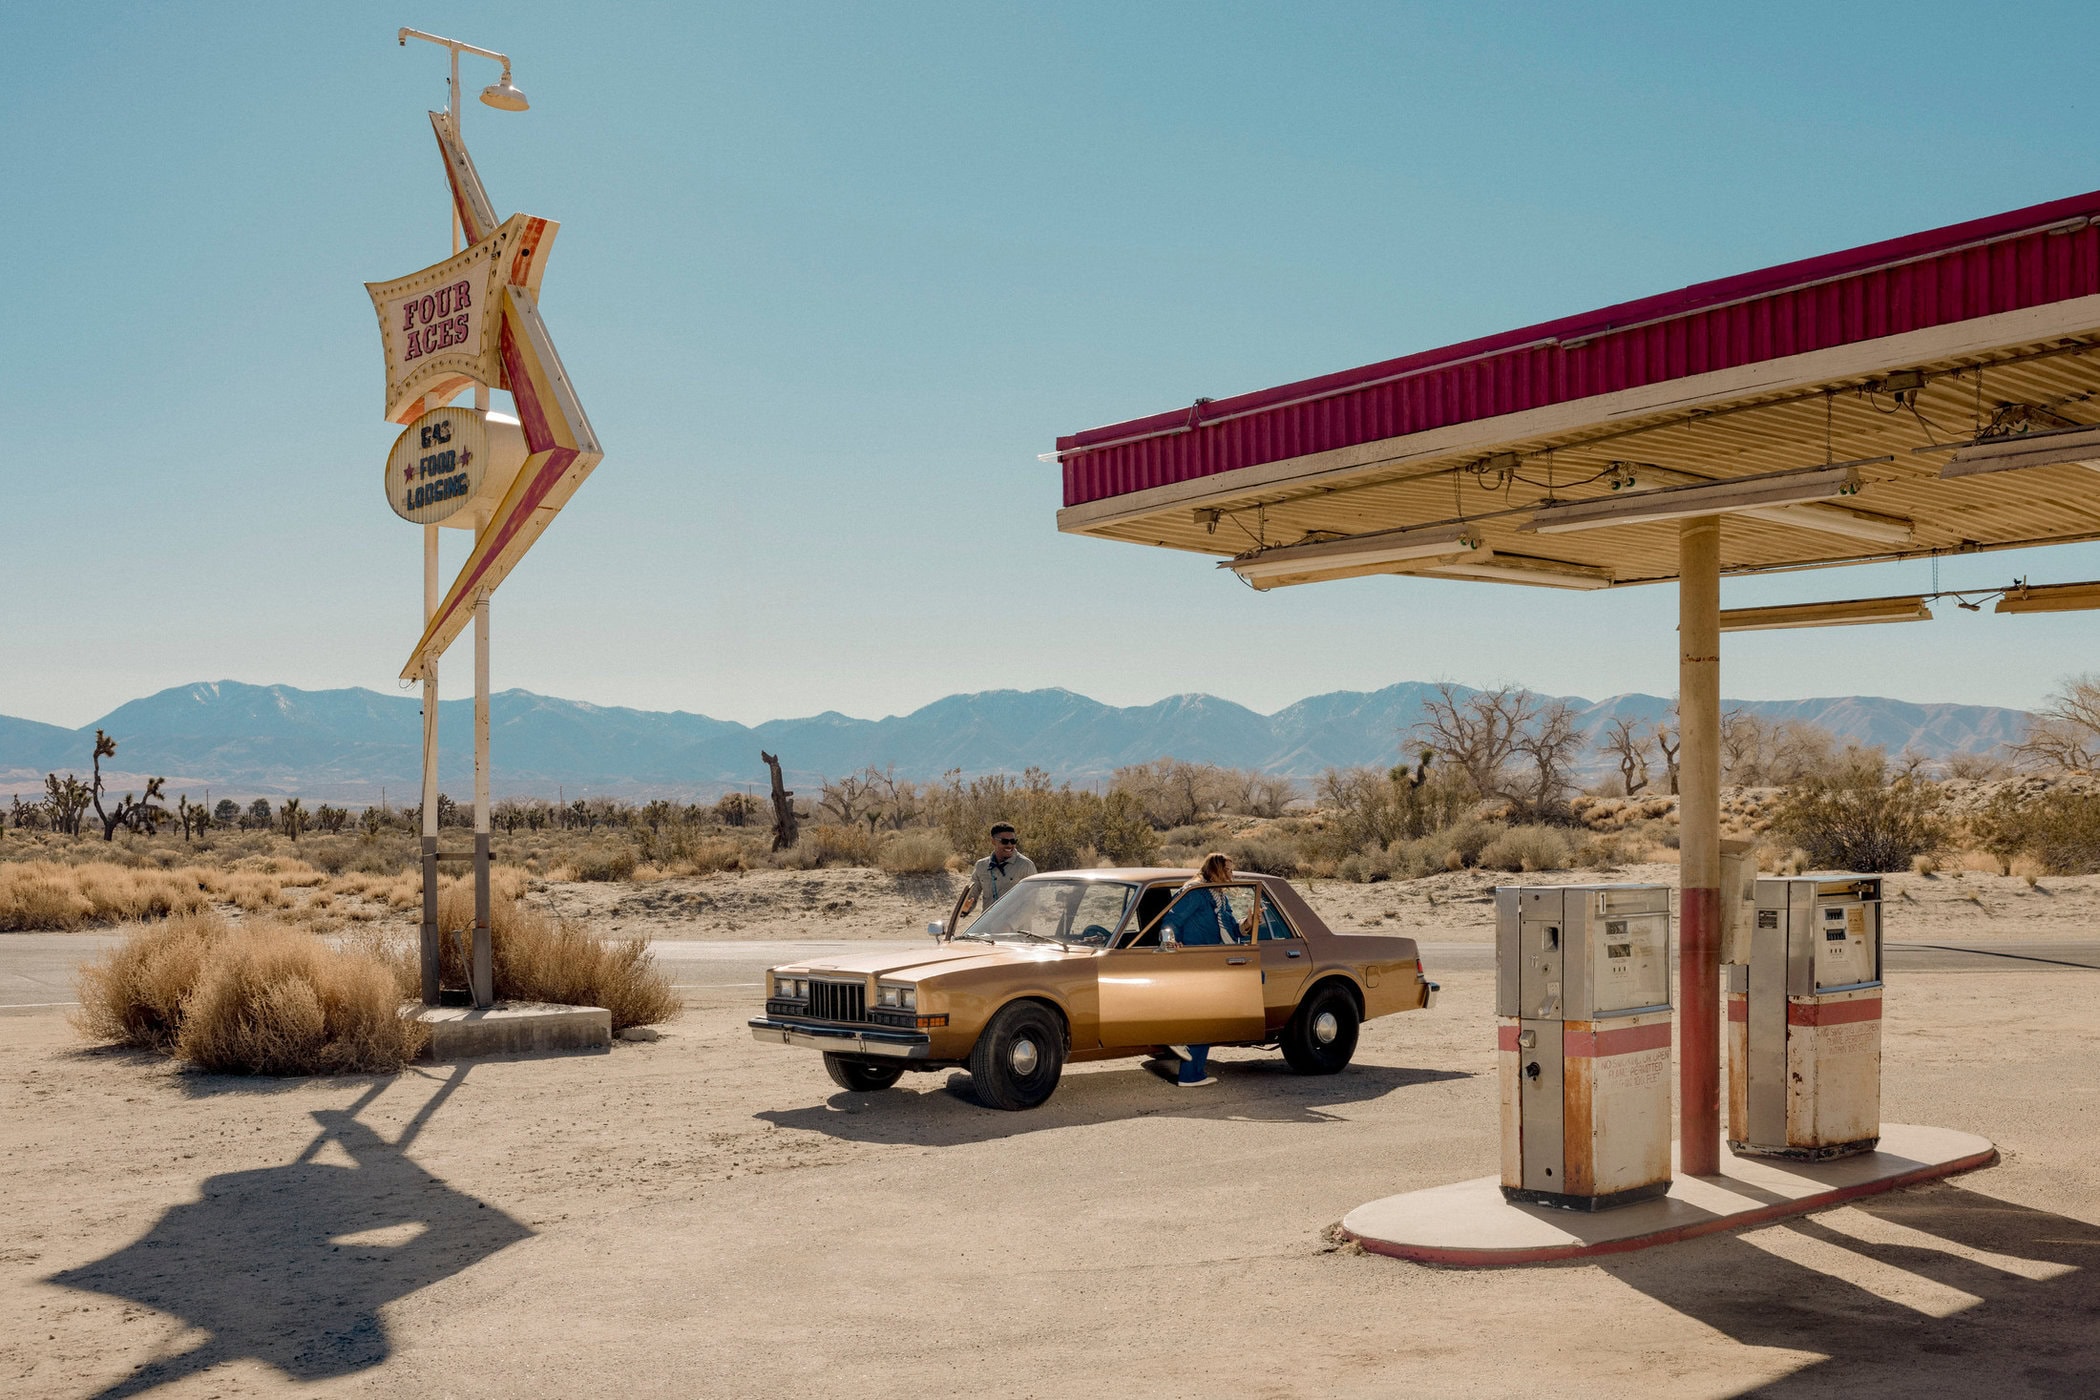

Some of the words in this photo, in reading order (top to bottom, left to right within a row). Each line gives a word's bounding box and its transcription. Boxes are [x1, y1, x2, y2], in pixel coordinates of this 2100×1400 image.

[403, 280, 471, 331] FOUR
[404, 313, 469, 361] ACES
[421, 420, 452, 449] GAS
[420, 450, 456, 480] FOOD
[407, 473, 469, 511] LODGING
